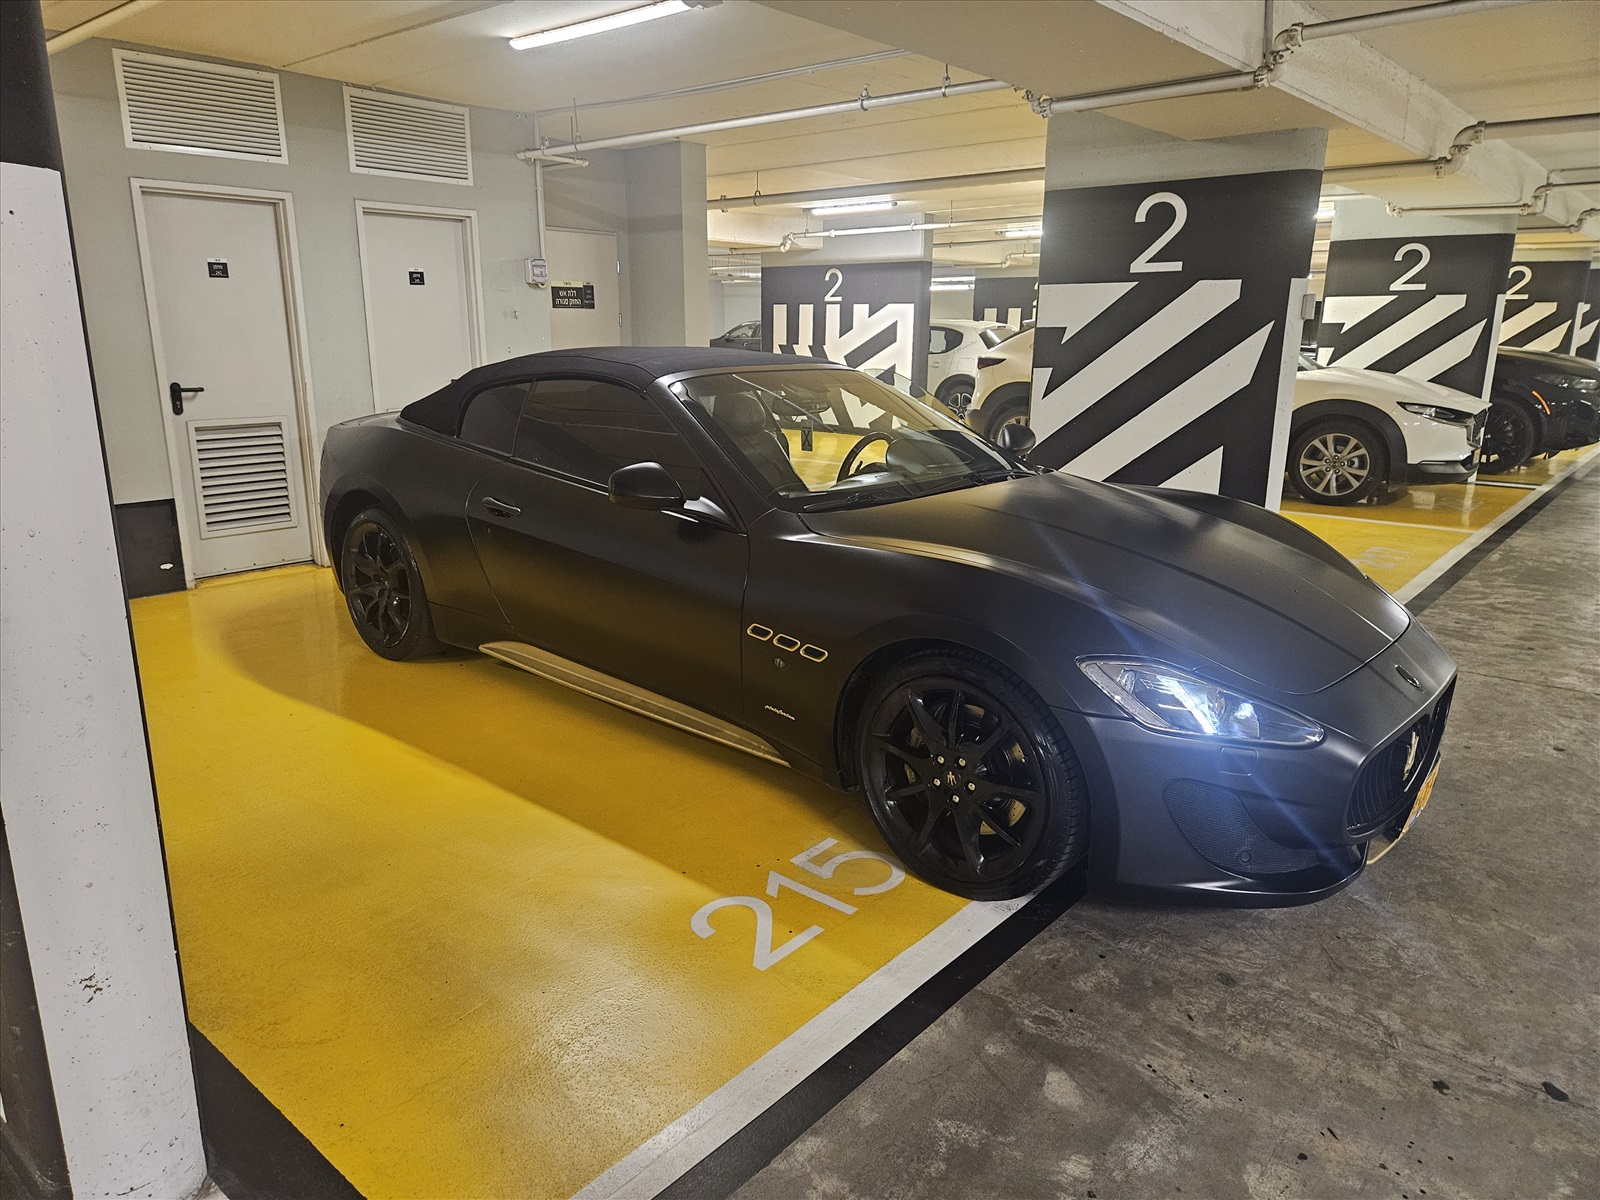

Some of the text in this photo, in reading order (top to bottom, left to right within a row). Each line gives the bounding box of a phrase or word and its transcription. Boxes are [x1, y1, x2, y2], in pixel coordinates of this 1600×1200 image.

[1130, 192, 1188, 274] 2
[824, 268, 843, 302] 2
[1390, 243, 1431, 291] 2
[1504, 265, 1533, 300] 2
[690, 837, 906, 972] 215
